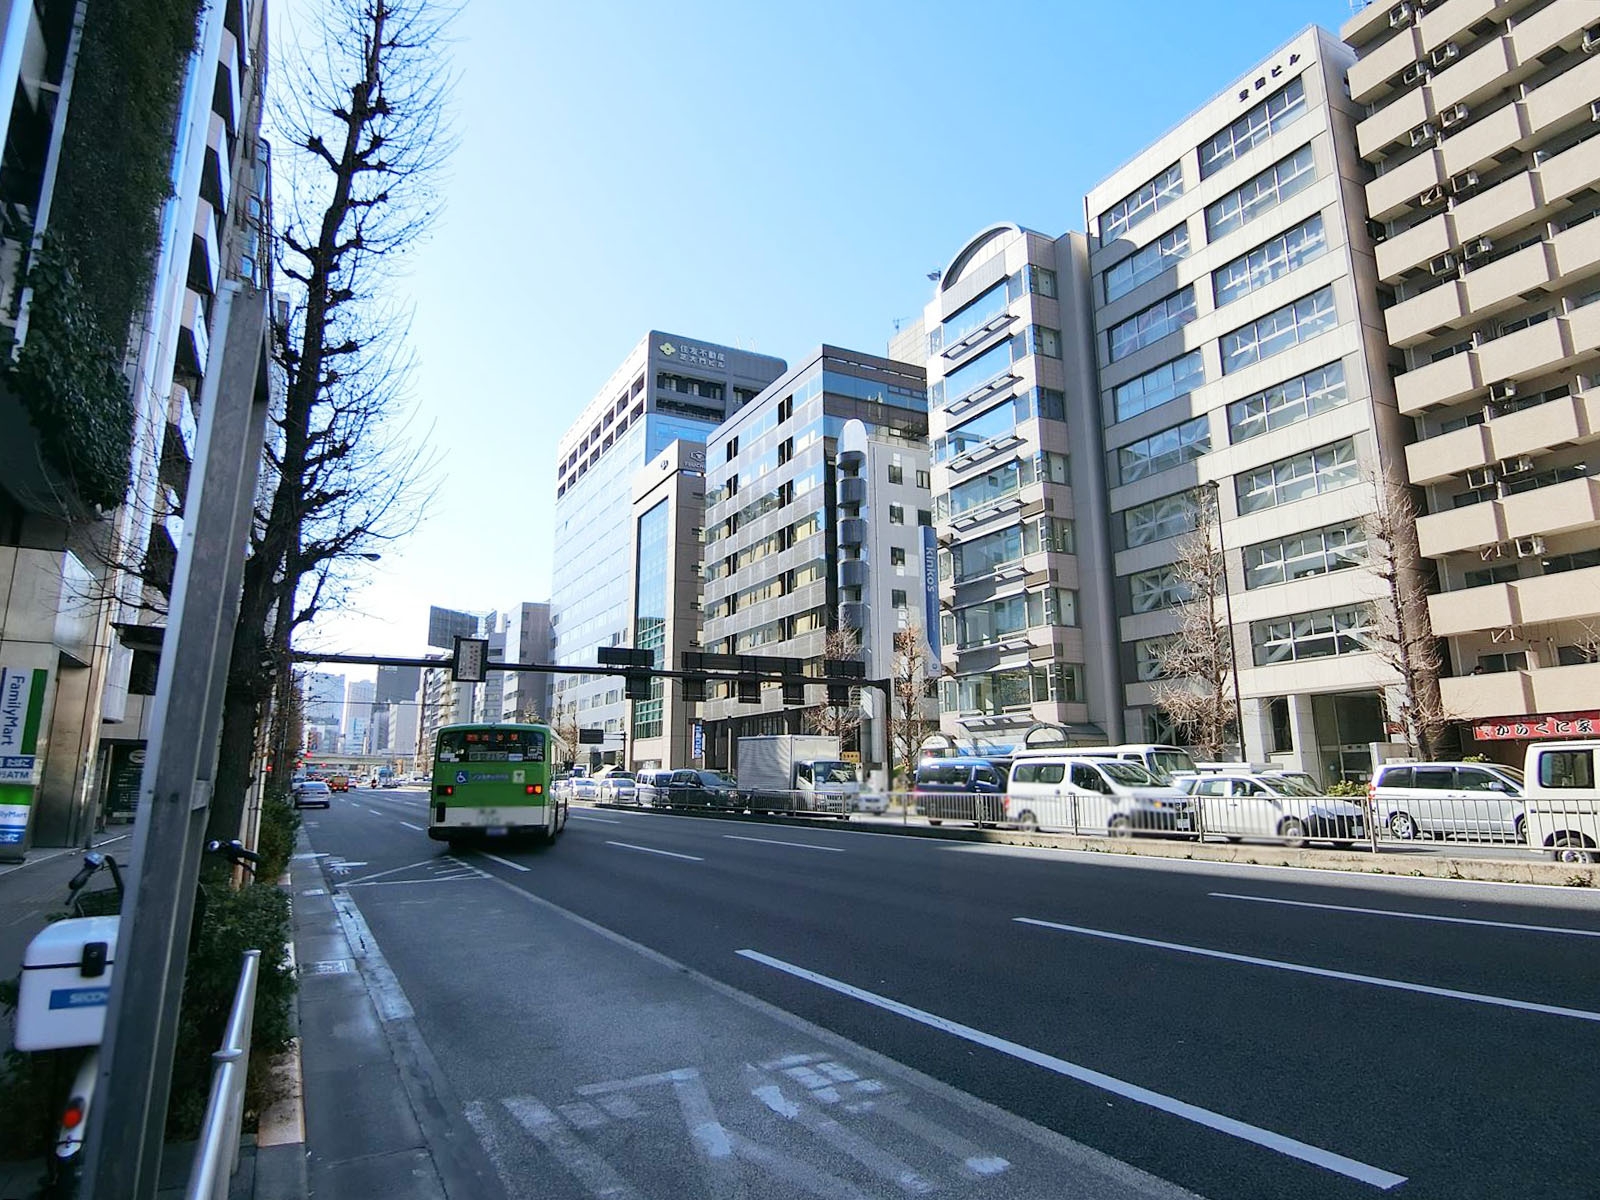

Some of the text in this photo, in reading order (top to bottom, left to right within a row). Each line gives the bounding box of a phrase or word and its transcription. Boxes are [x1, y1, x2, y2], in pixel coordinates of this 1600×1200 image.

[1, 675, 25, 746] FamilyMart
[1496, 719, 1594, 736] からくに家
[69, 991, 109, 1005] SECO
